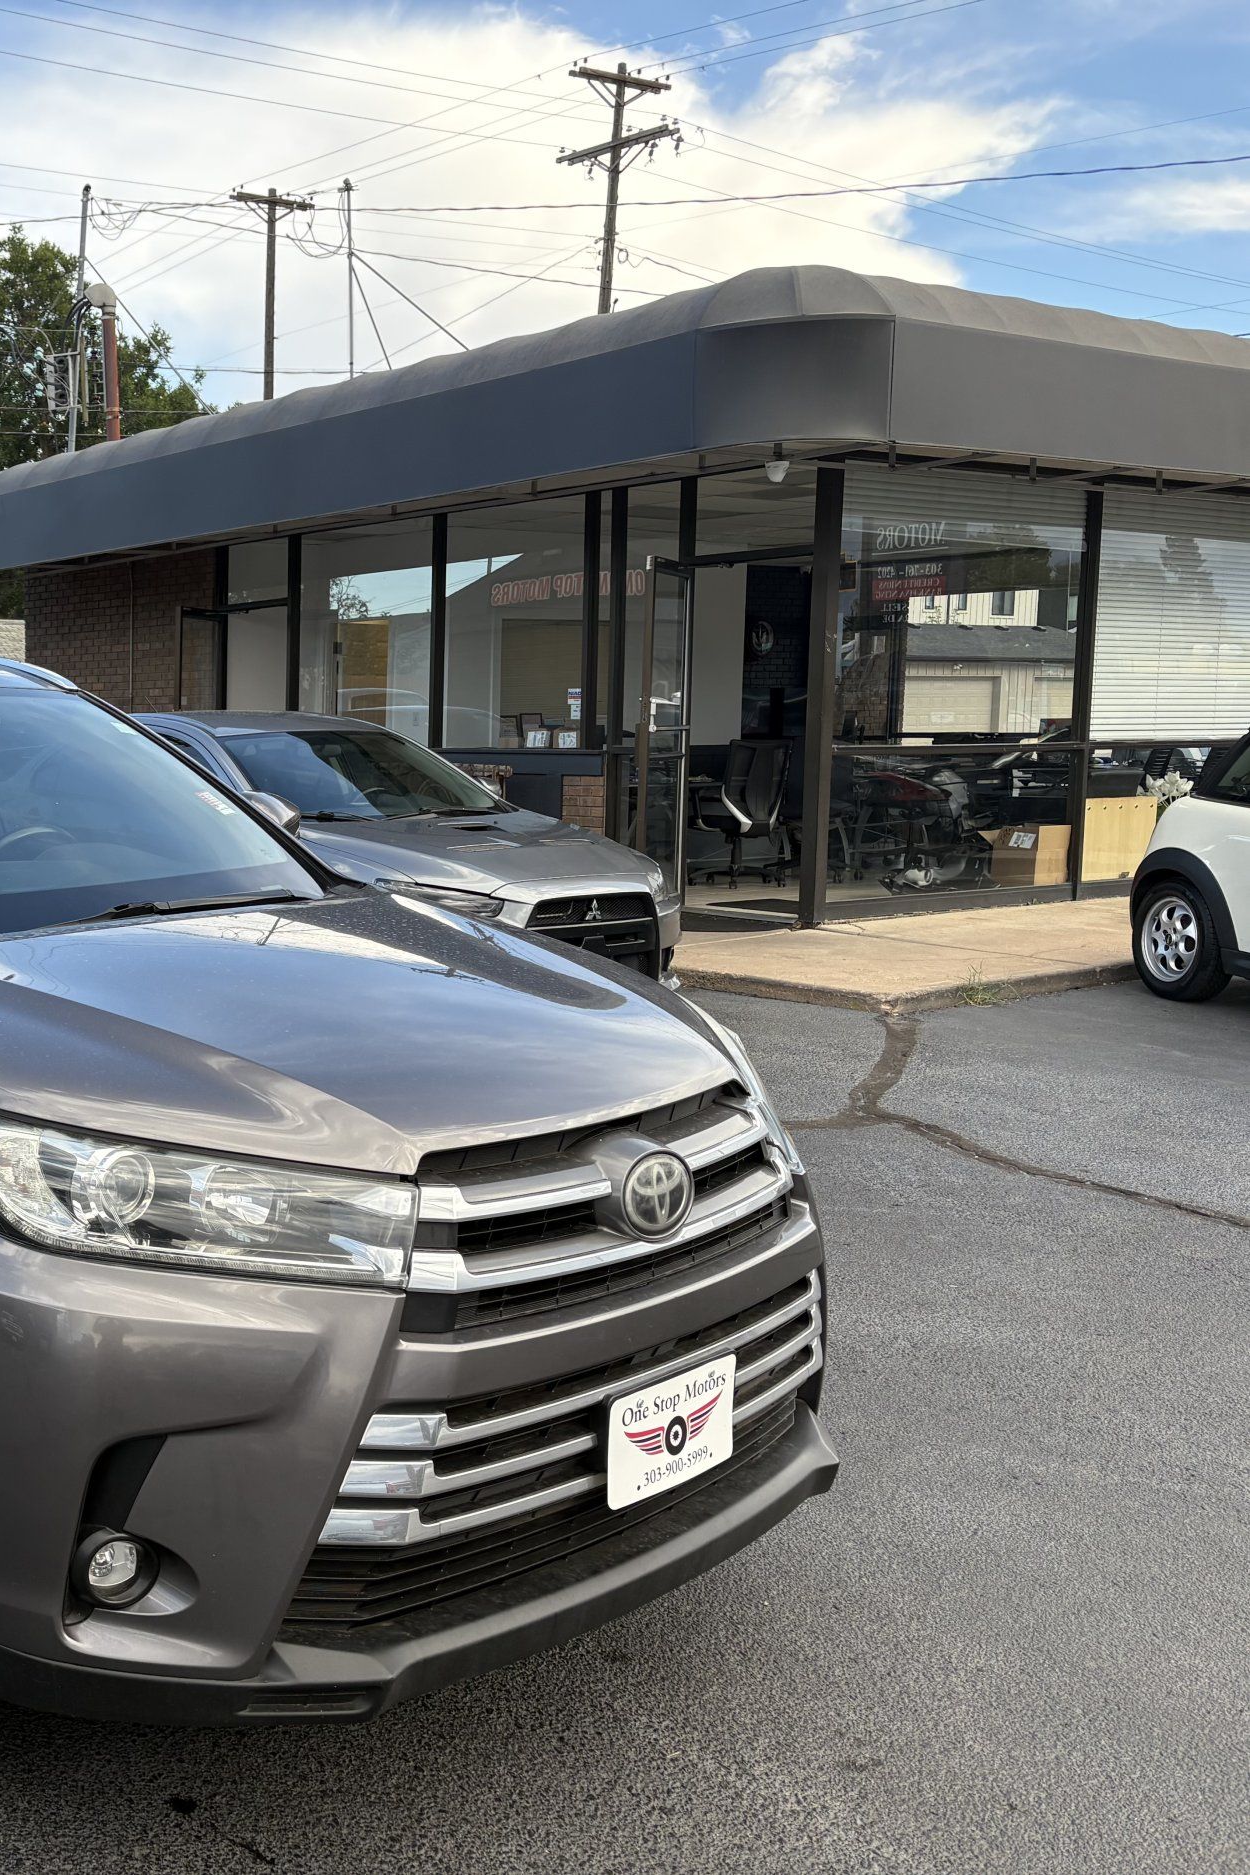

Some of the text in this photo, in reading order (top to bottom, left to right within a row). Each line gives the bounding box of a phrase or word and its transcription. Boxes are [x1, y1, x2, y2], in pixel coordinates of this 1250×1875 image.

[622, 1373, 727, 1427] One Stop Motors
[643, 1445, 709, 1487] 303-900-5999
